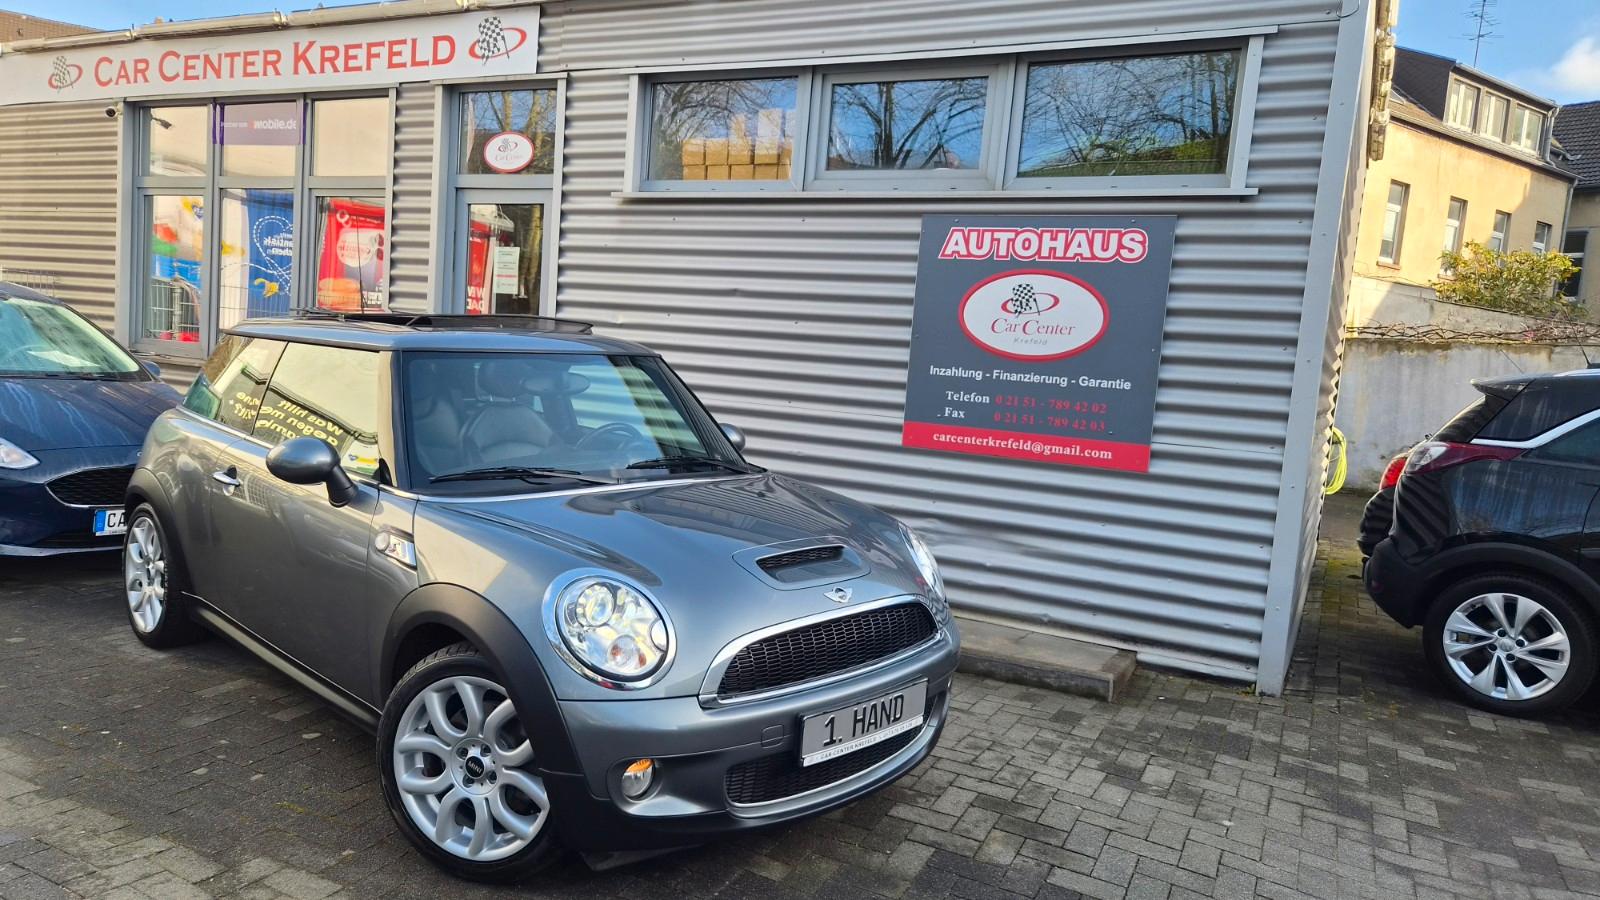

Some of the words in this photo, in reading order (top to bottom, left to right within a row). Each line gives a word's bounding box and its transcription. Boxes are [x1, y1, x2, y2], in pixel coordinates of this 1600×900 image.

[94, 56, 150, 88] CAR
[157, 48, 282, 83] CENTER
[292, 35, 457, 76] KREFELD
[938, 227, 1149, 263] AUTOHAUS
[991, 317, 1020, 336] Car
[1022, 319, 1076, 337] Center
[930, 365, 983, 381] Inzahlung
[992, 369, 1068, 387] Finanzierung
[1078, 376, 1132, 390] Garantie
[946, 390, 990, 404] Telefon
[944, 407, 965, 419] Fax
[933, 432, 1113, 460] carcenterkrefeld@gmail.com
[852, 693, 904, 738] HAND
